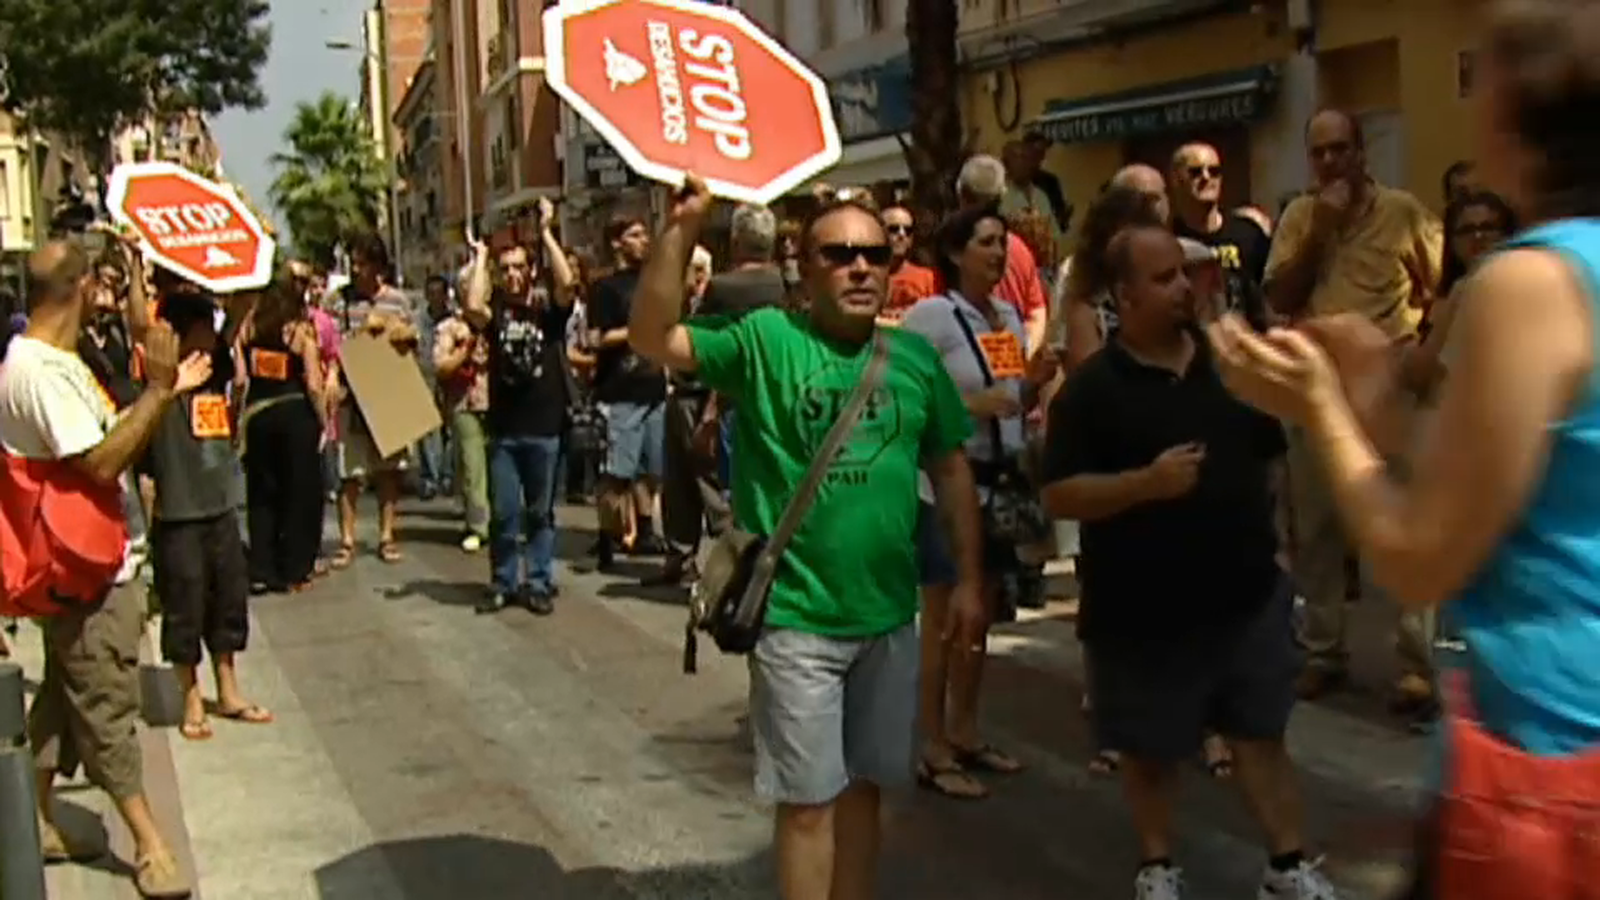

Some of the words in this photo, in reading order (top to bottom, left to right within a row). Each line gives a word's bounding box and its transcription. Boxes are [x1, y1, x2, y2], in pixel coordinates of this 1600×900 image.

[679, 27, 752, 160] STOP
[136, 202, 231, 235] STOP
[800, 386, 886, 421] STP
